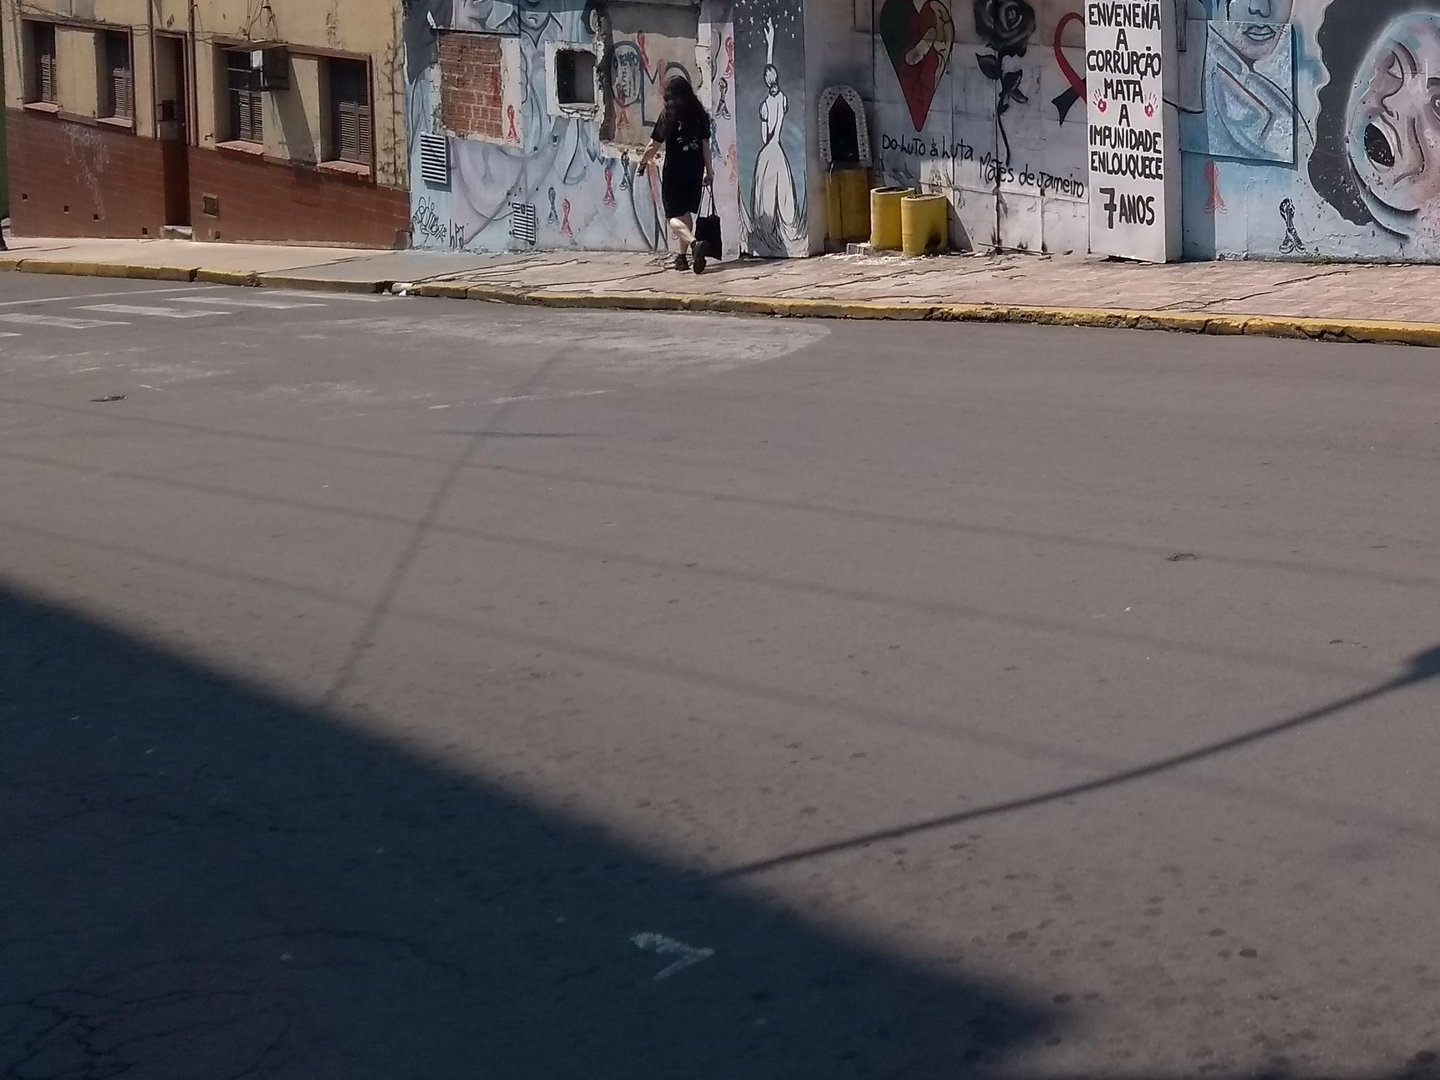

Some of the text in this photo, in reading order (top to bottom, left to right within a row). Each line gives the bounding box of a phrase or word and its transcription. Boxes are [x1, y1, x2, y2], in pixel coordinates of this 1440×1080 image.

[1088, 2, 1161, 30] ENVENENA
[1116, 29, 1128, 50] A
[1103, 78, 1143, 103] MATA
[1118, 104, 1130, 127] A
[1089, 124, 1162, 154] IMPUNIDADE
[1019, 163, 1035, 185] de
[1090, 150, 1163, 180] ENLOUQUECE
[1099, 187, 1155, 229] 7 ANOS
